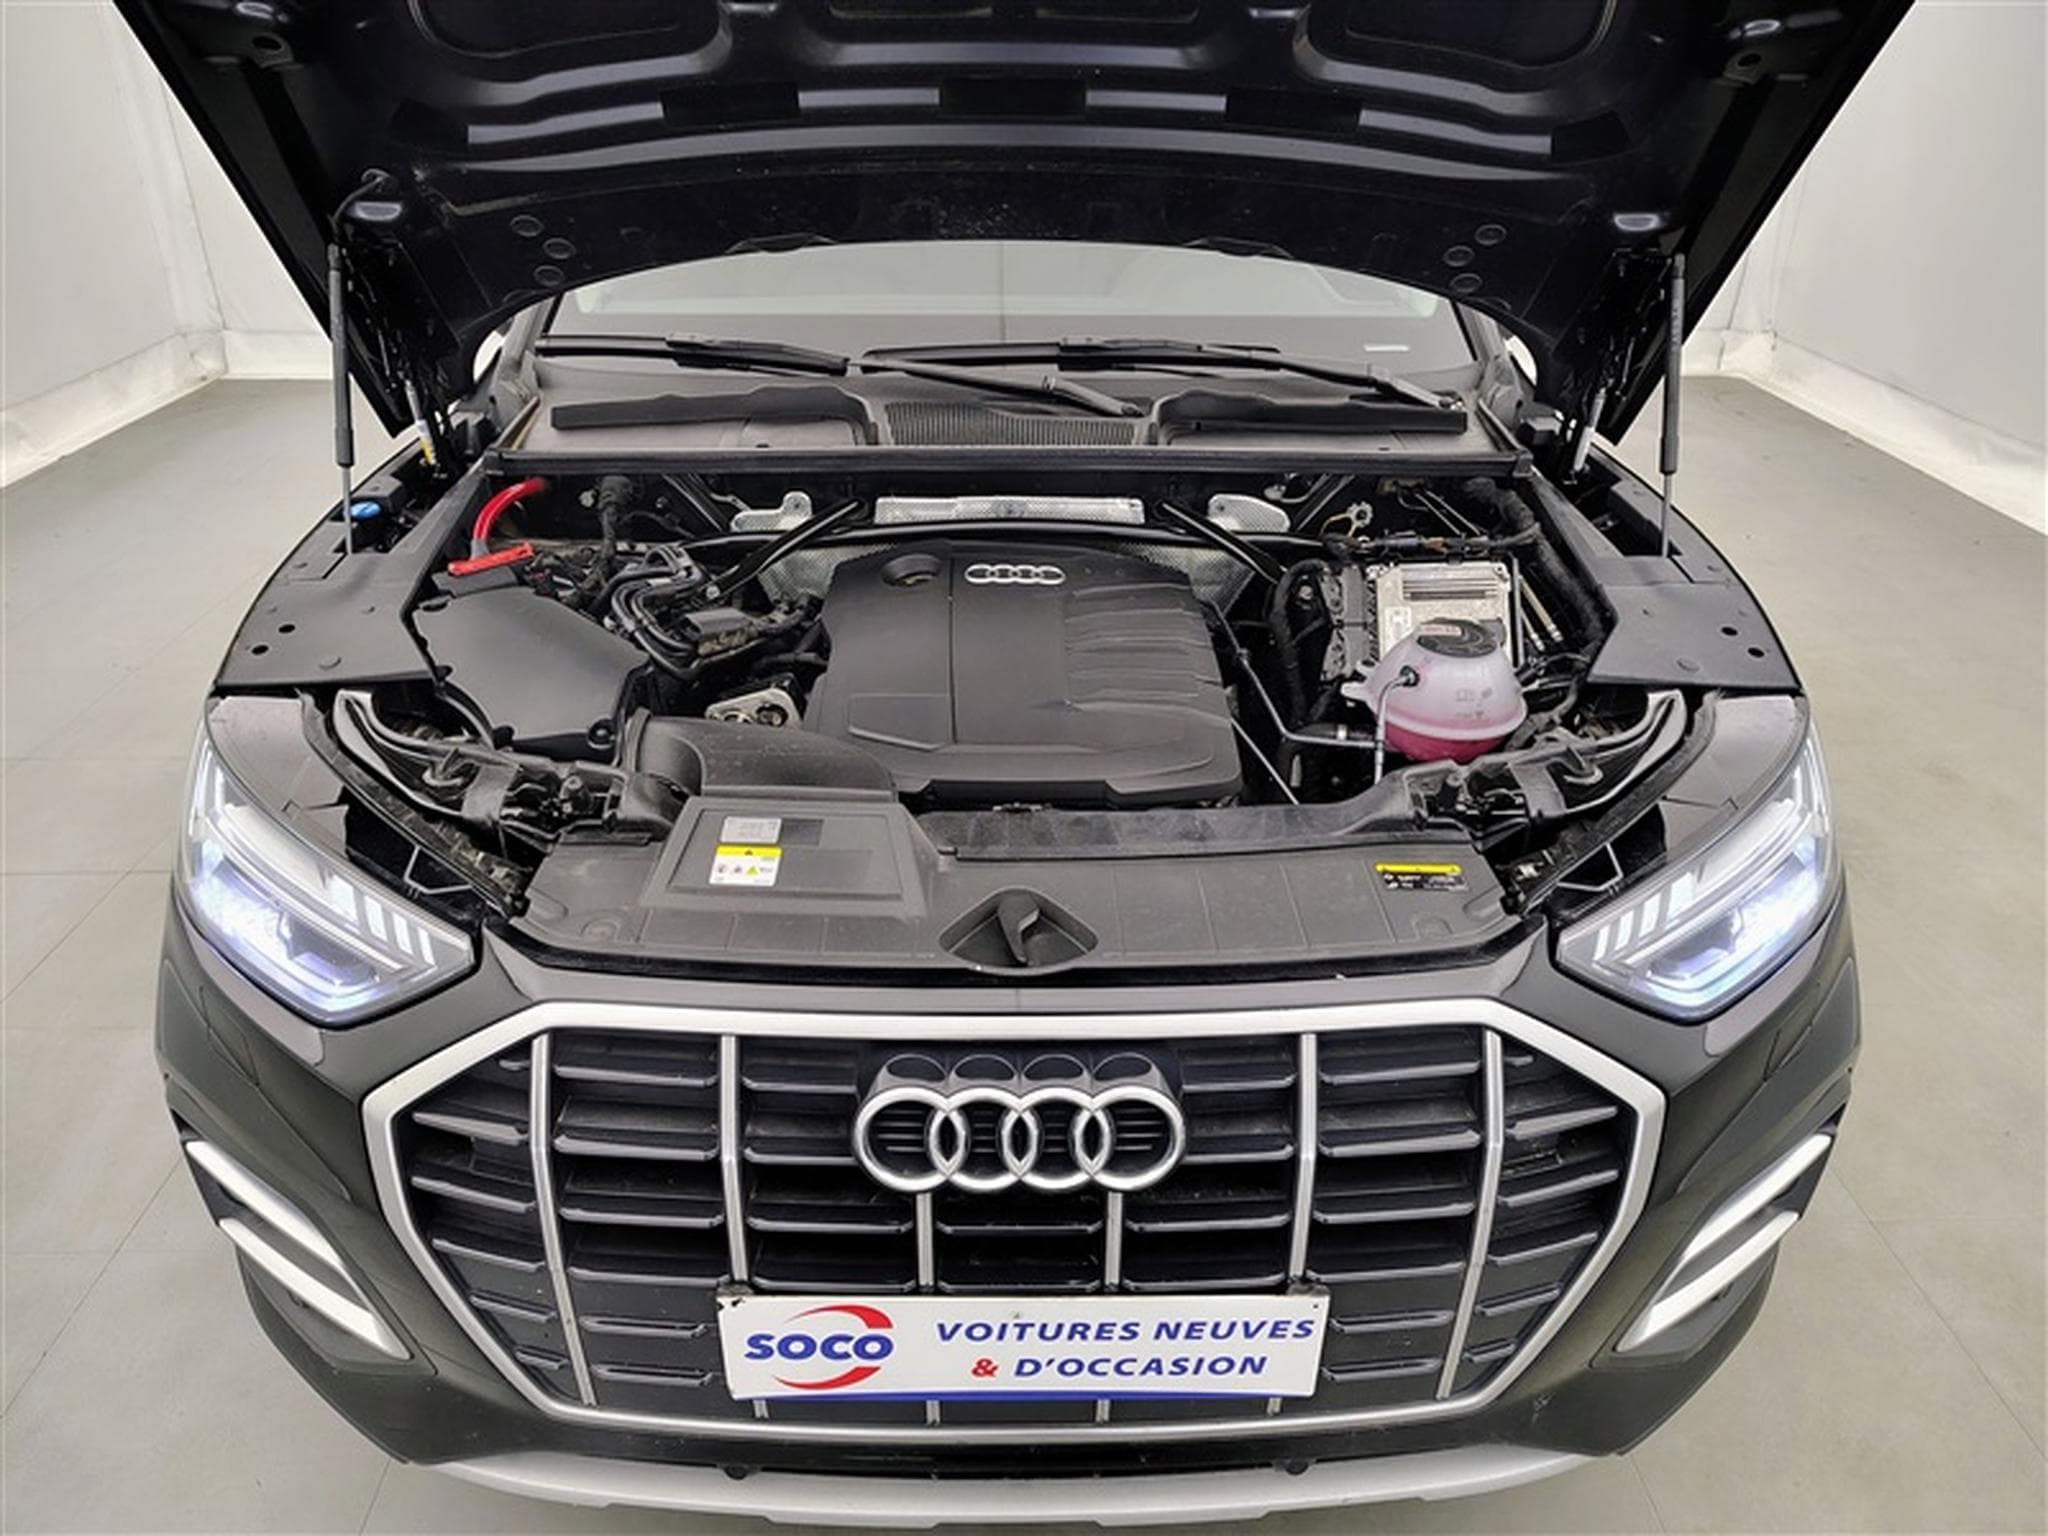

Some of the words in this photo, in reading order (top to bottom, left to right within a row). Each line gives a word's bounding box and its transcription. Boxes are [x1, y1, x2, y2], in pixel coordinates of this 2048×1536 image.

[937, 1320, 1140, 1343] VOITURES
[1152, 1317, 1315, 1341] NEUVES
[744, 1332, 894, 1362] SOCO
[971, 1358, 998, 1379] &
